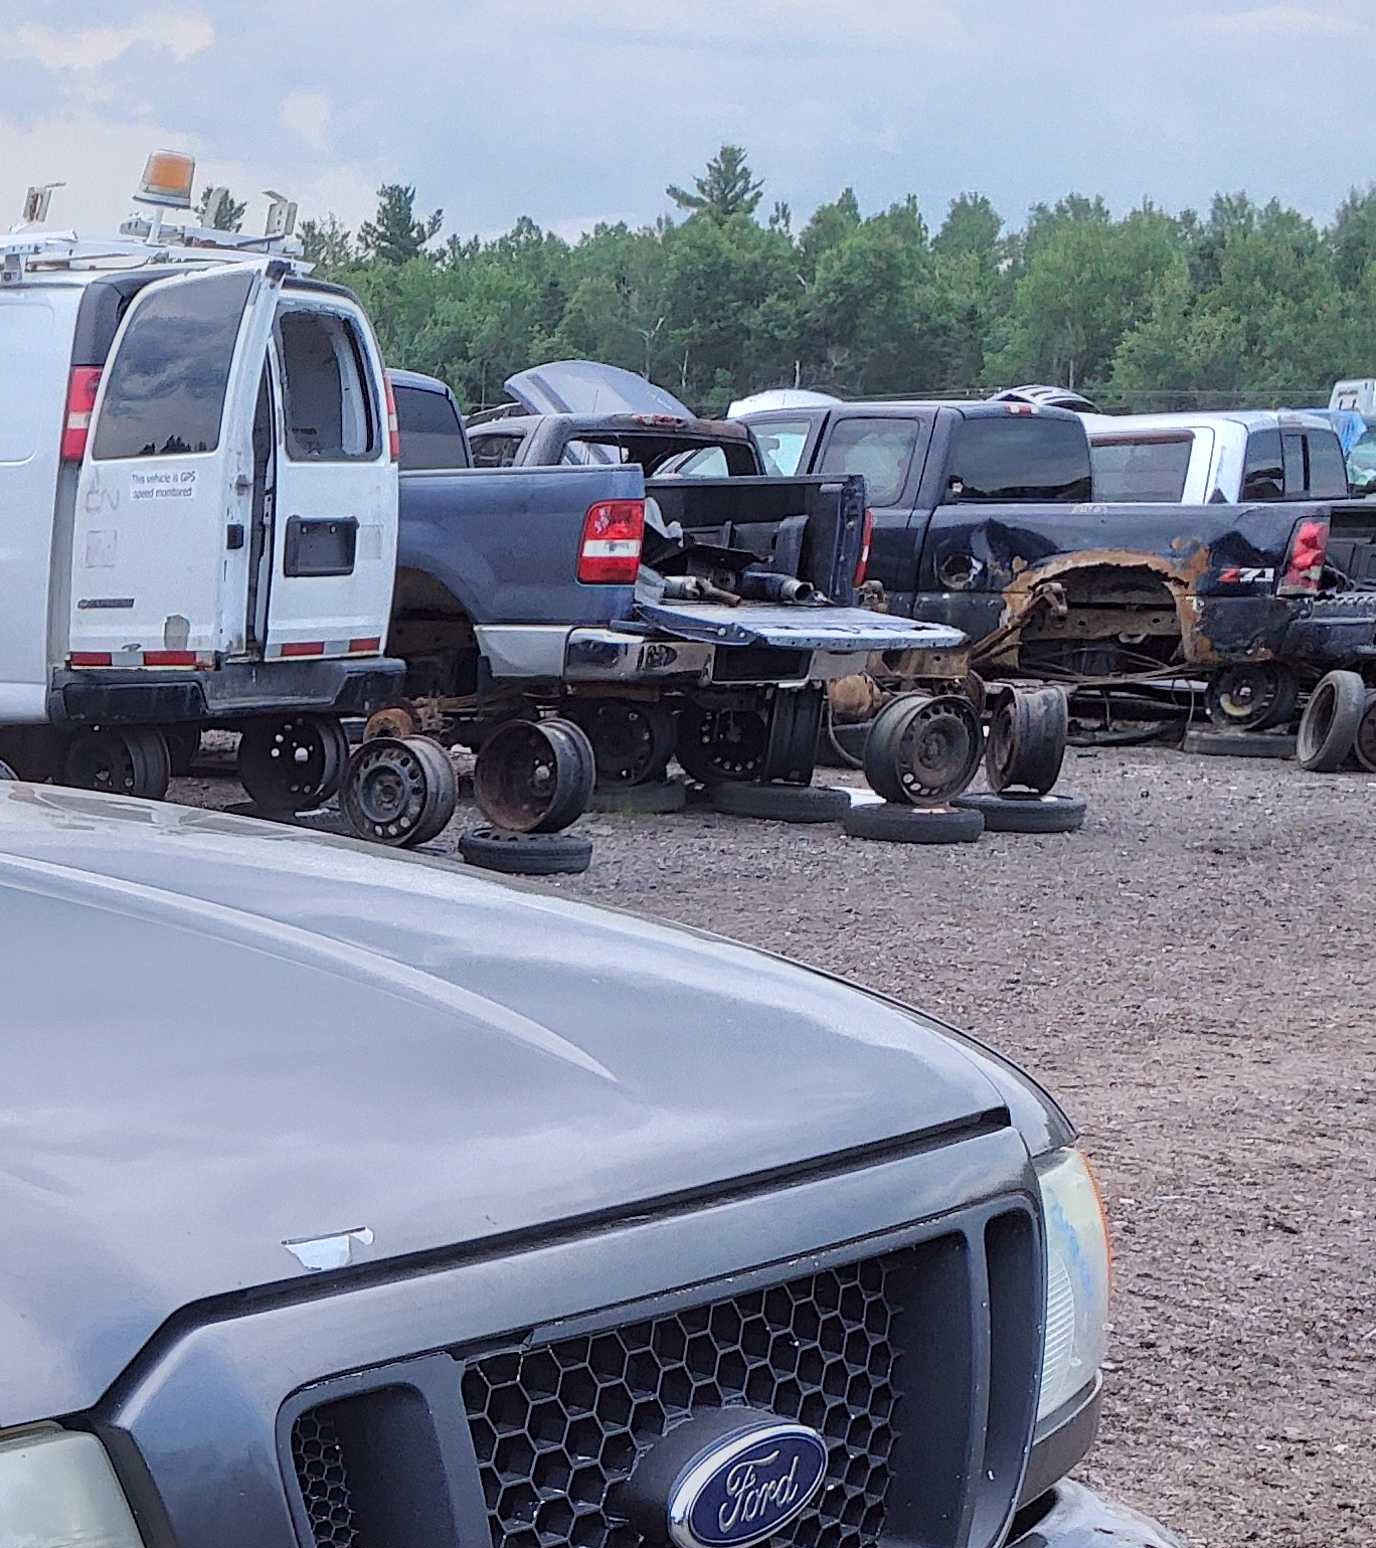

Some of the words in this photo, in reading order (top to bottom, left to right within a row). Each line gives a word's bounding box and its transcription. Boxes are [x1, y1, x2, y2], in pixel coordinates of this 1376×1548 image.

[147, 473, 171, 484] vehicle
[180, 470, 197, 483] GPS
[133, 487, 154, 499] speed
[155, 486, 193, 497] monitored
[1218, 567, 1275, 583] Z71
[718, 1449, 799, 1534] Ford
